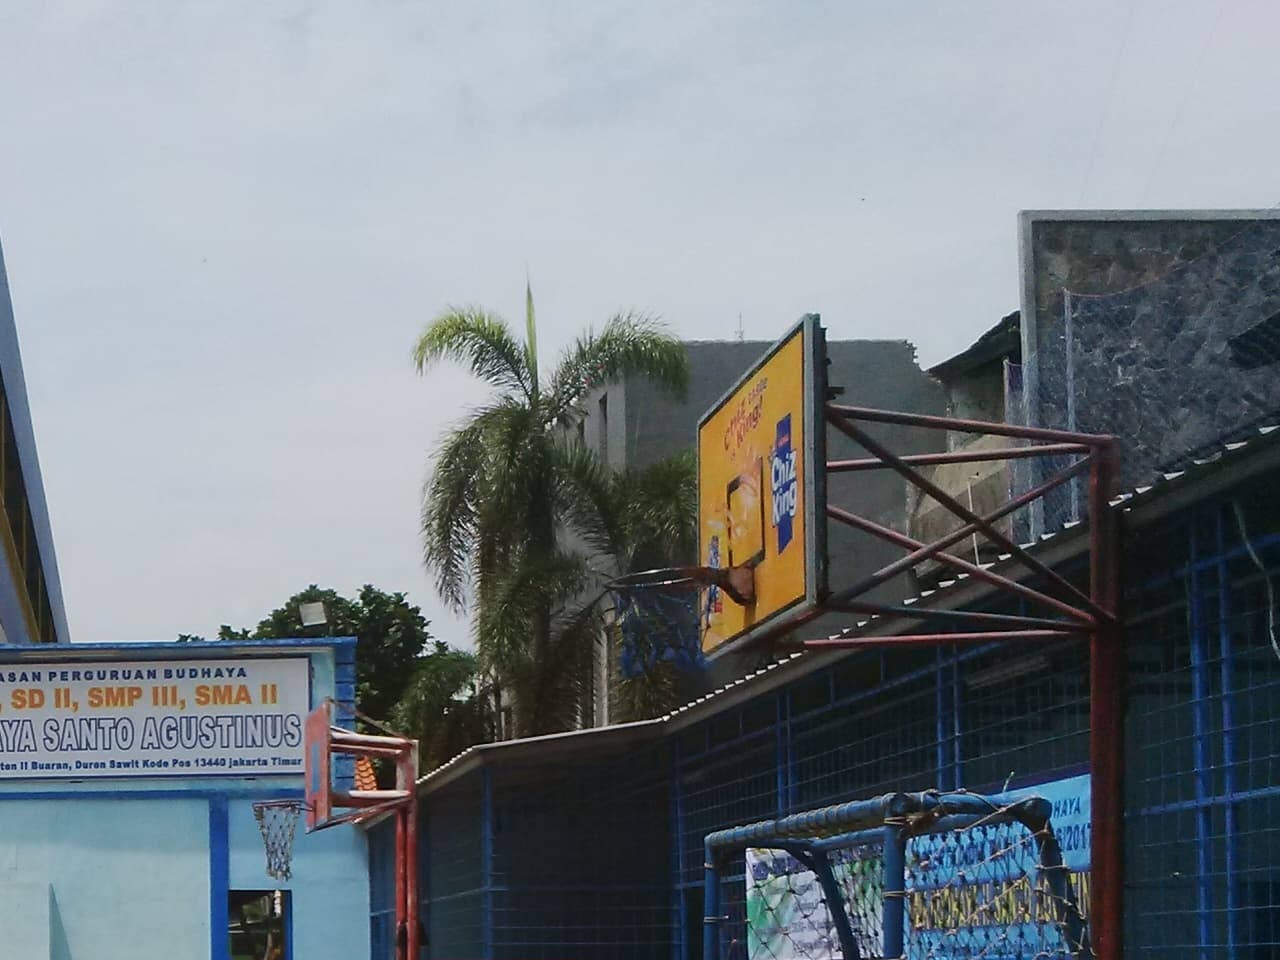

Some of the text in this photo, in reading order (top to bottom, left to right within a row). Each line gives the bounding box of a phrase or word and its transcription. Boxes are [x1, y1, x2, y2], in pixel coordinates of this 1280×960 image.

[772, 481, 798, 526] King
[48, 669, 157, 683] PERGURUAN
[163, 667, 247, 680] BUDHAYA
[11, 688, 45, 709] SD
[54, 688, 78, 713] II,
[87, 686, 143, 708] SMP
[152, 686, 186, 710] III,
[194, 684, 253, 706] SMA
[260, 683, 277, 705] II
[42, 718, 134, 751] SANTO
[140, 714, 301, 750] AGUSTINUS
[20, 761, 28, 771] II
[31, 760, 72, 773] Buaran,
[109, 759, 139, 769] Sawit
[142, 758, 169, 769] Kode
[172, 758, 191, 768] Pos
[195, 757, 226, 768] 13440
[271, 756, 303, 767] Timur
[1052, 797, 1081, 819] HAYA
